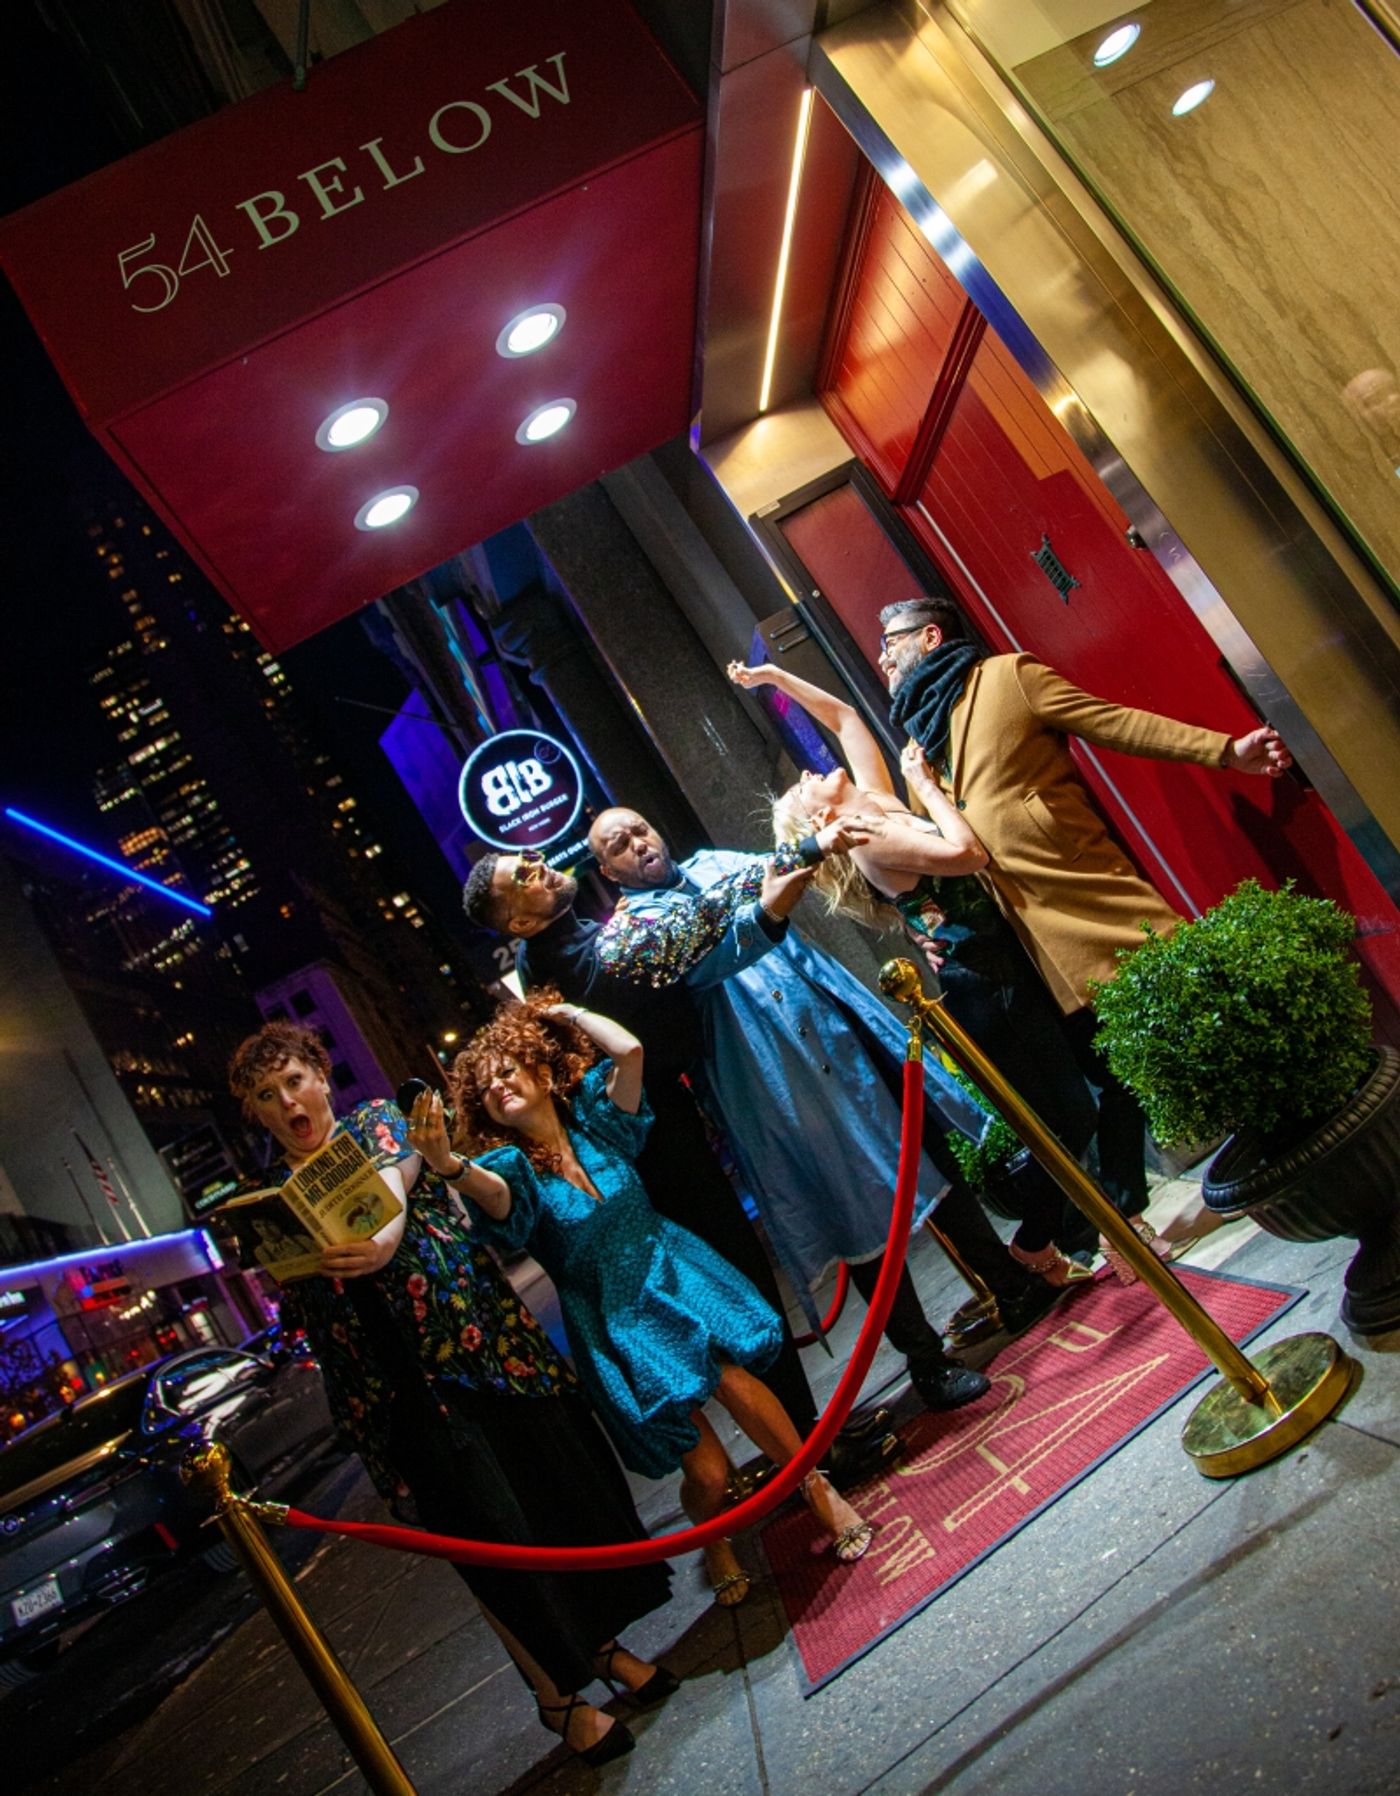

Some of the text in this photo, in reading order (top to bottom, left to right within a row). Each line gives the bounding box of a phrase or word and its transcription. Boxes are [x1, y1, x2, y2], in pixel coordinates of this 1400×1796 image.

[118, 51, 573, 314] 54 BELOW
[498, 792, 570, 835] BLACK IRON BURGER
[293, 1135, 356, 1191] LOOKING FOR
[303, 1150, 367, 1208] MR. GOODBAR
[318, 1194, 344, 1219] JUDITH
